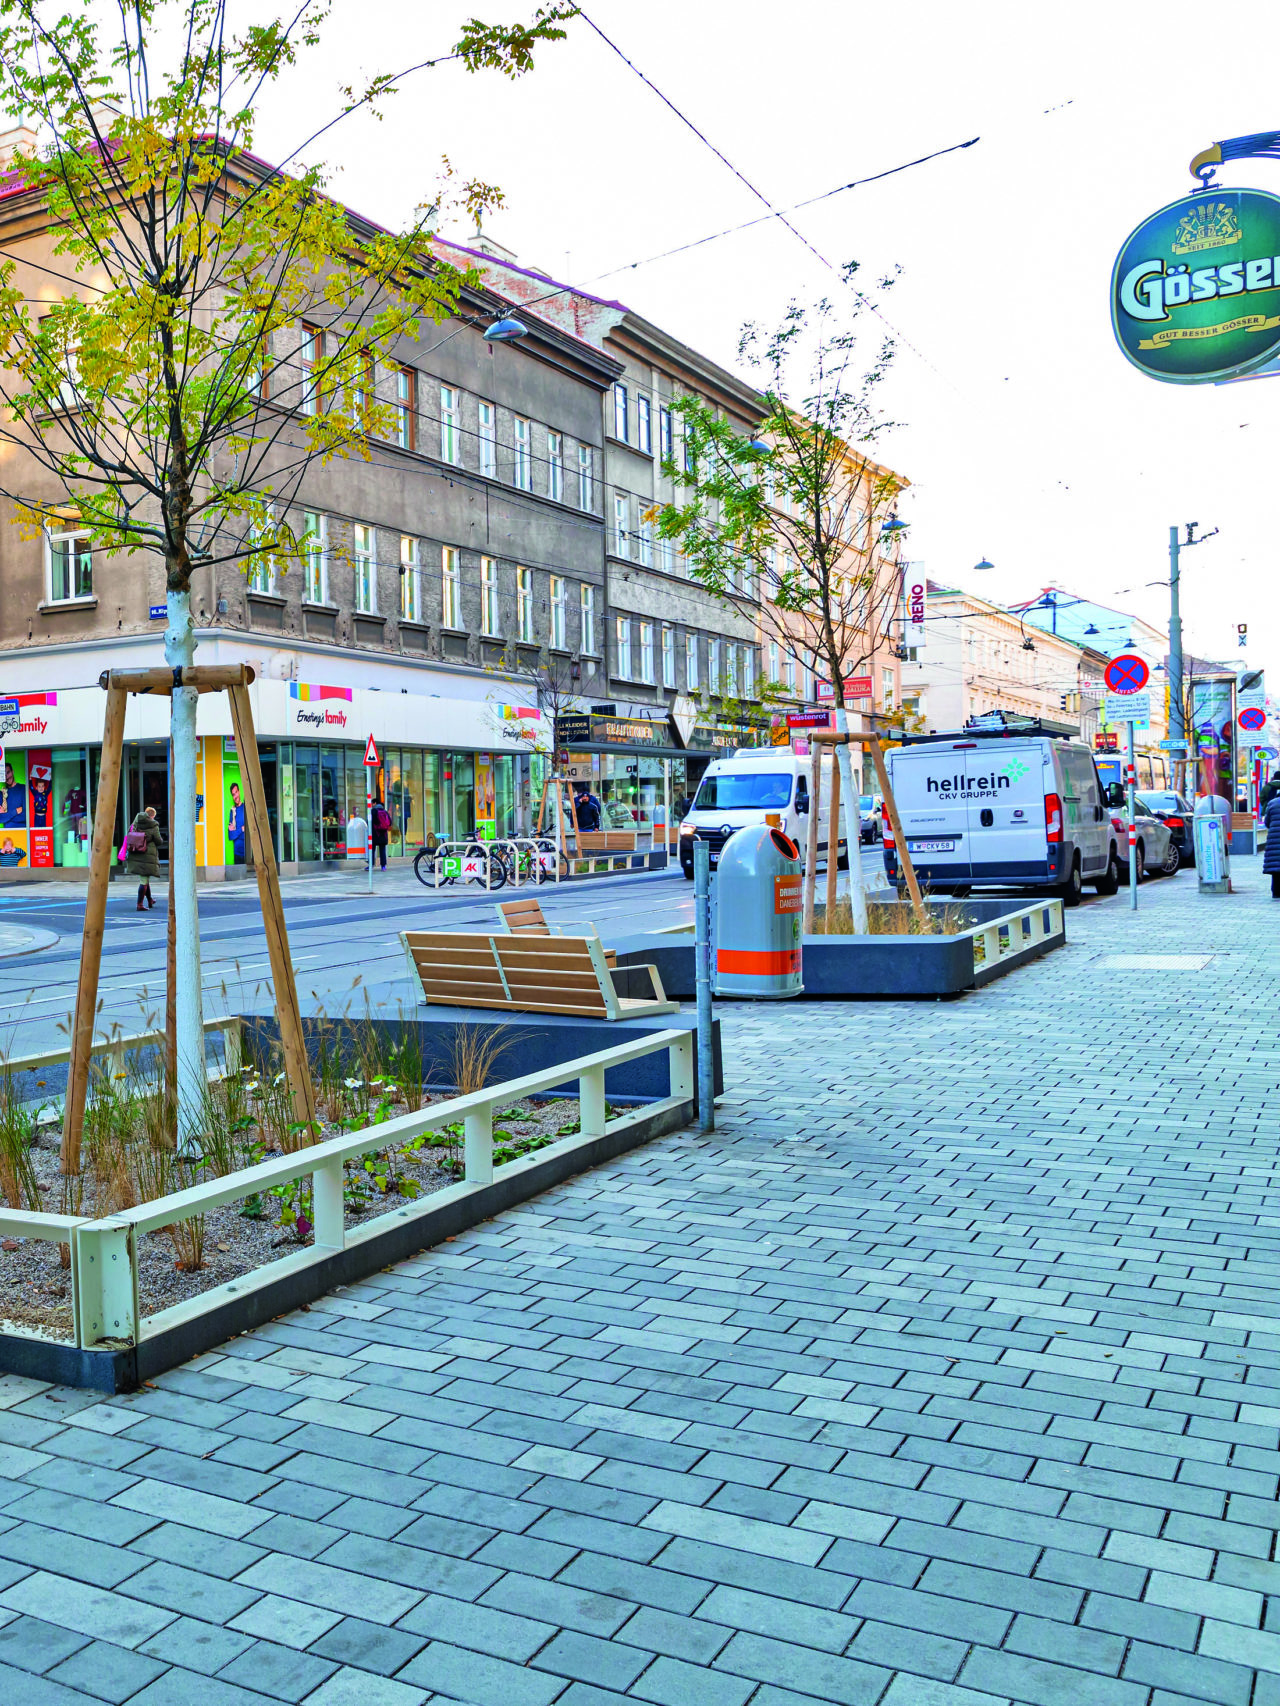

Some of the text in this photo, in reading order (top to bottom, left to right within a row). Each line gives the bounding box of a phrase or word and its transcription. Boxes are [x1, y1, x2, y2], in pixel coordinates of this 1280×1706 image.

[1120, 256, 1280, 321] Gösse
[1159, 317, 1259, 340] GUT BESSER GÖSSER
[911, 584, 924, 624] RENO
[13, 716, 47, 734] amily
[325, 709, 347, 728] family
[926, 772, 1010, 793] hellrein
[939, 790, 998, 800] CKV GRUPPE
[444, 859, 478, 876] P AK
